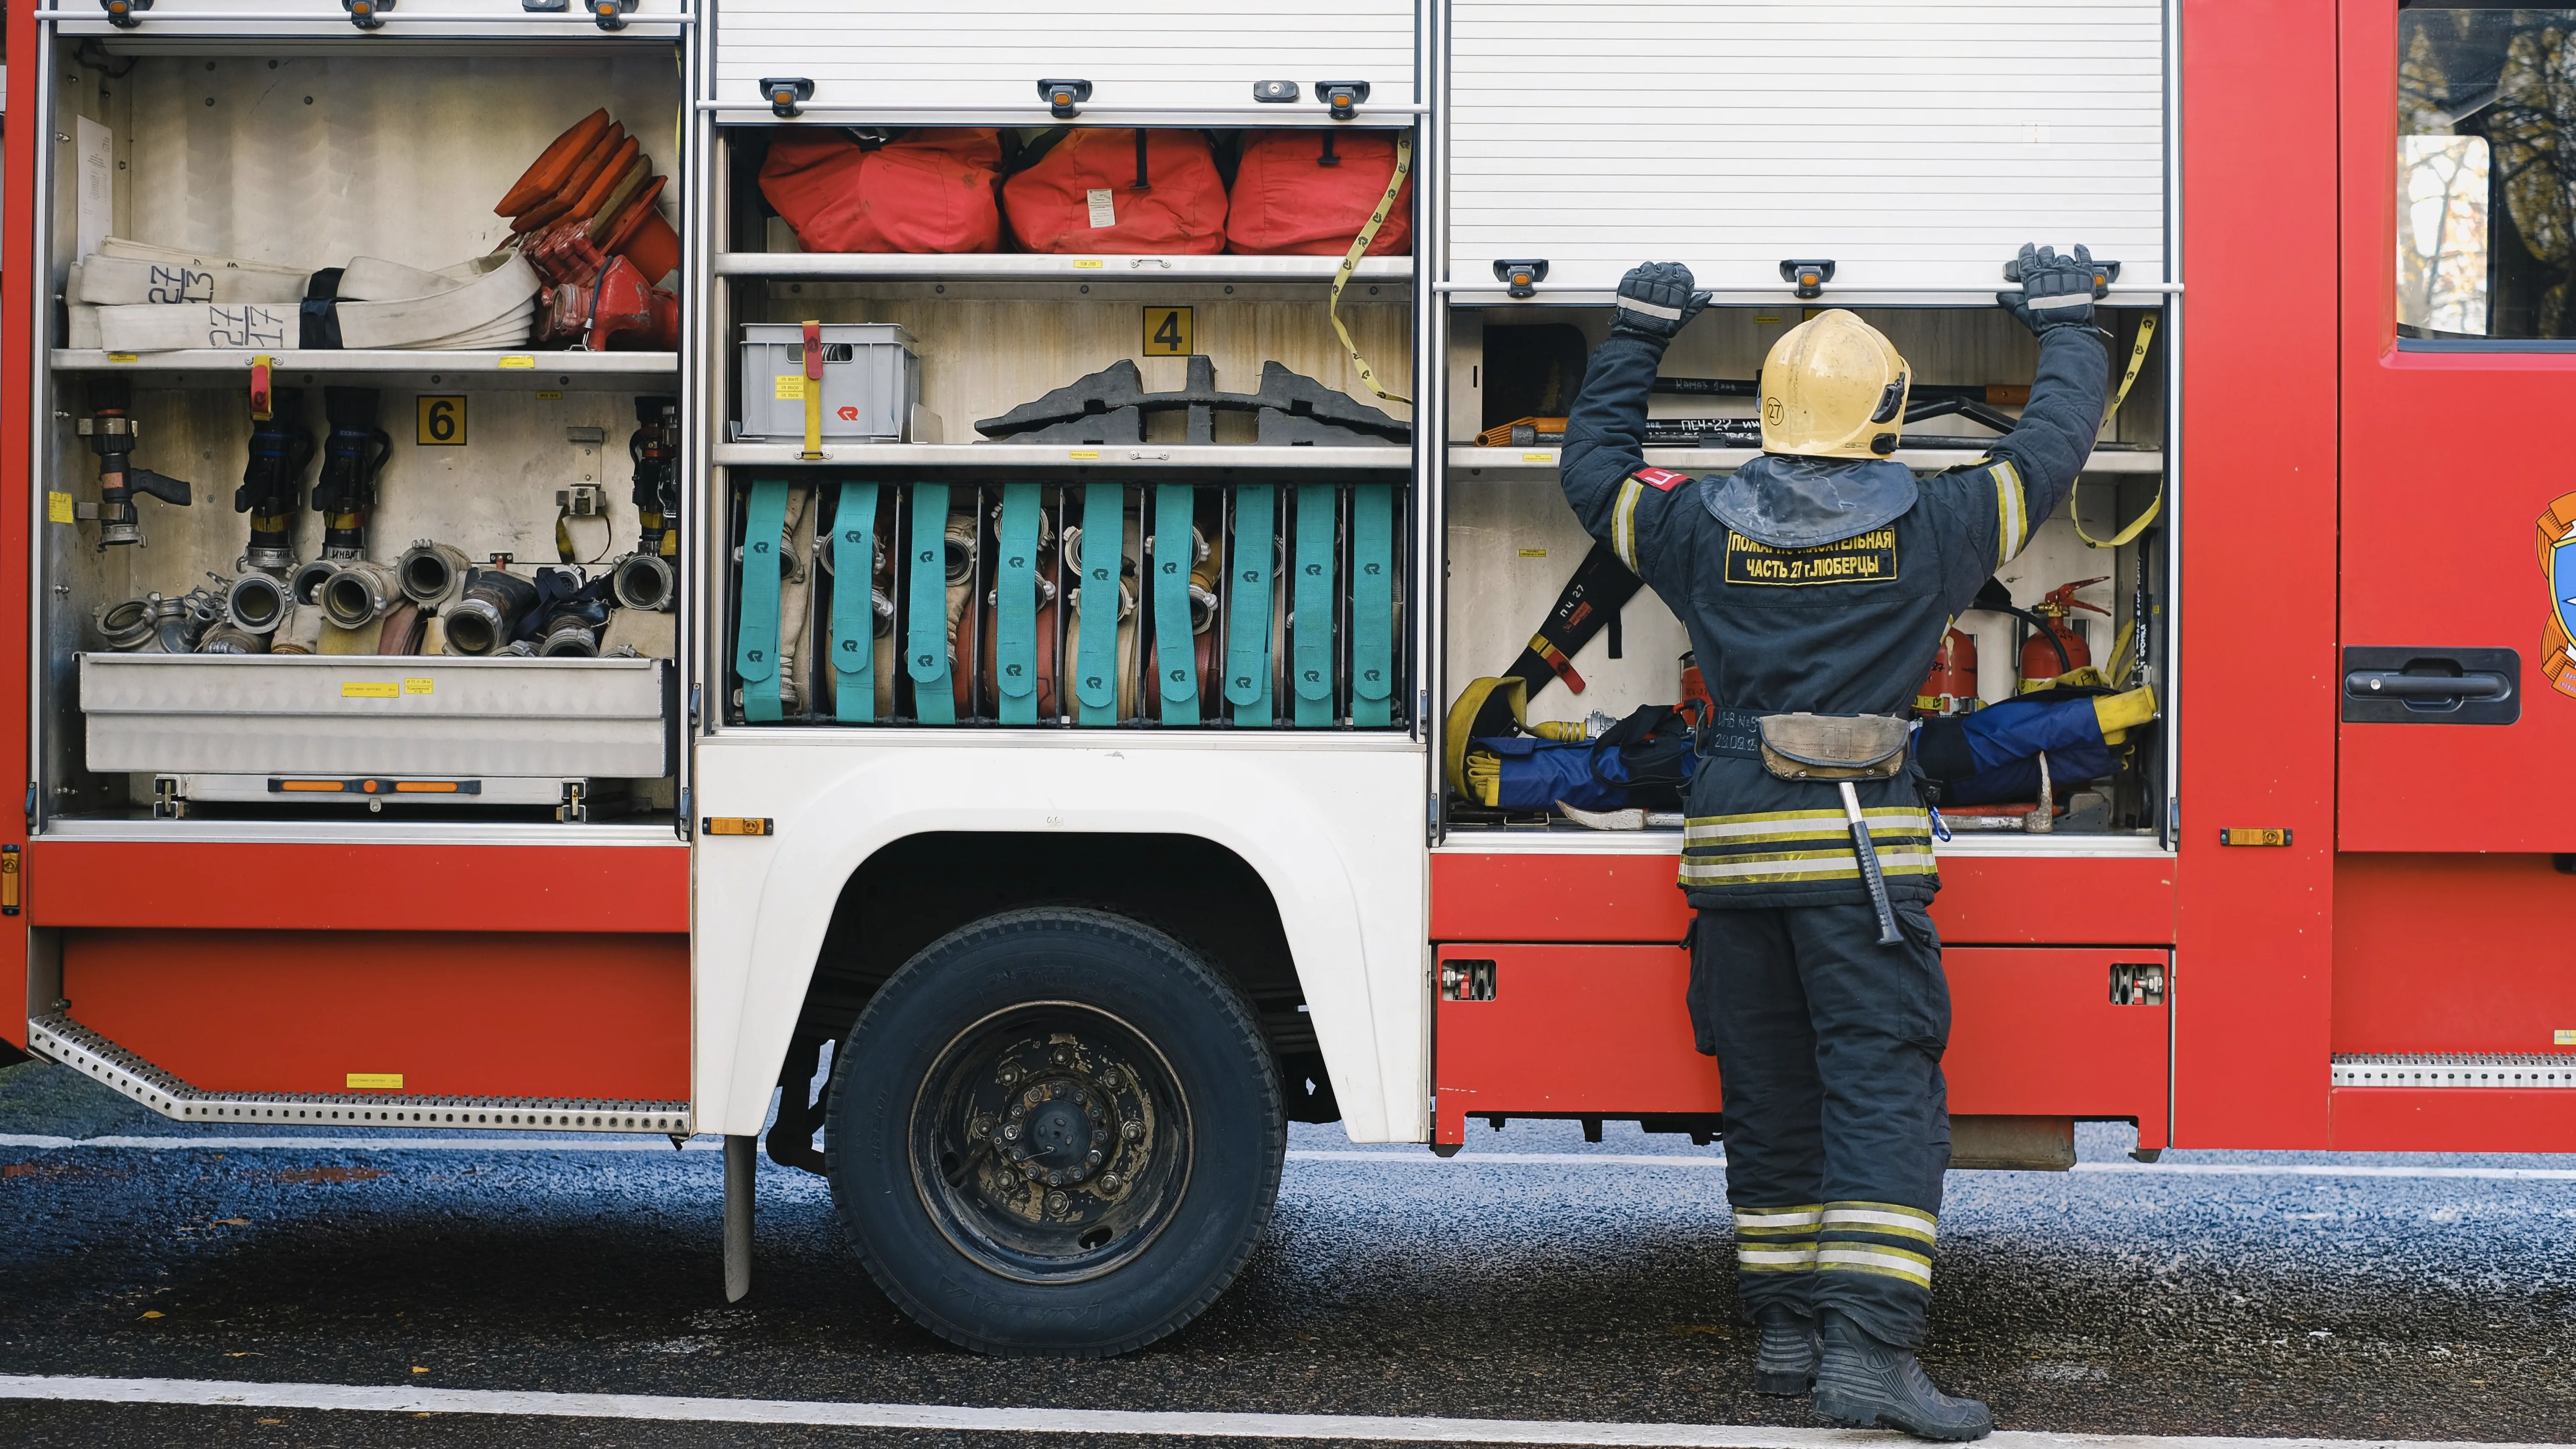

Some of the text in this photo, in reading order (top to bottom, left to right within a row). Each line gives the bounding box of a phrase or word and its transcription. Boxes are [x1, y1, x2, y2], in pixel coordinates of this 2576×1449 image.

[1154, 311, 1182, 351] 4
[429, 401, 456, 441] 6
[1768, 404, 1781, 419] 27
[1746, 558, 1788, 578] ЧАСТЬ
[1790, 560, 1803, 578] 27
